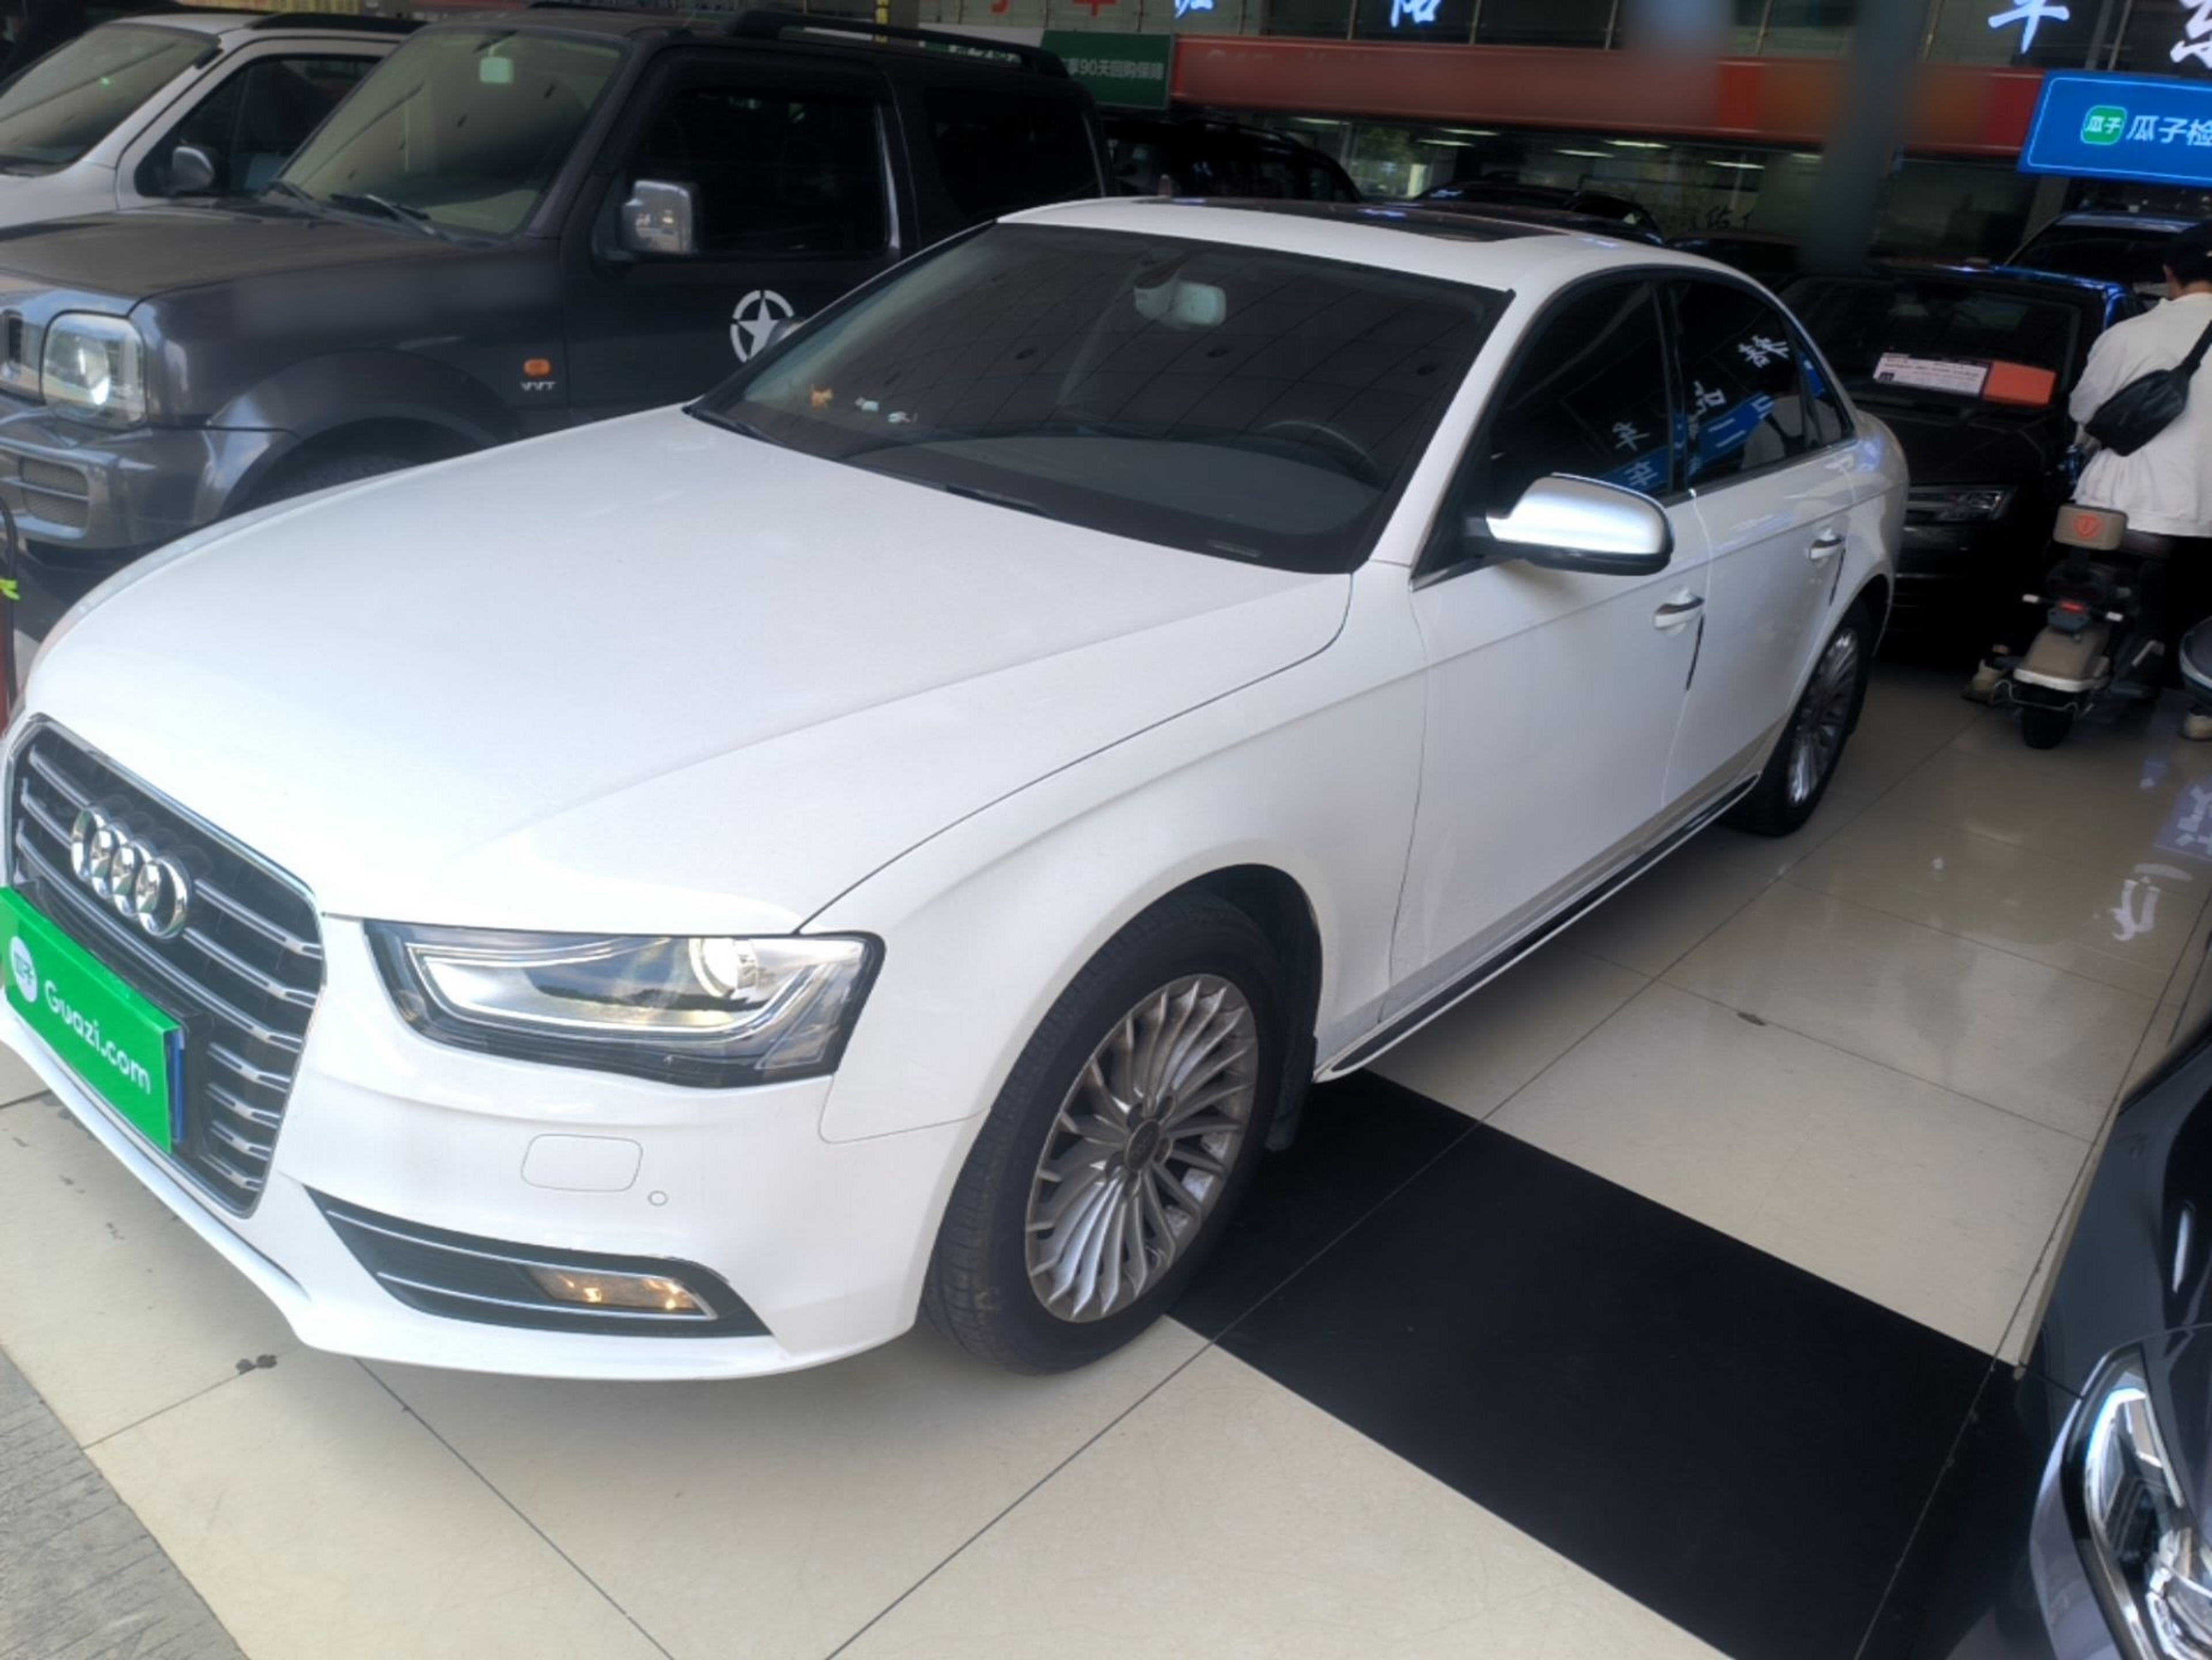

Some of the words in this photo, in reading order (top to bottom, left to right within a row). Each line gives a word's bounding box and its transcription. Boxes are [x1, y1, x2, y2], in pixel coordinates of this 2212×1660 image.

[2084, 115, 2123, 134] 瓜子
[520, 380, 557, 391] VVT
[43, 980, 151, 1094] Guazi.com
